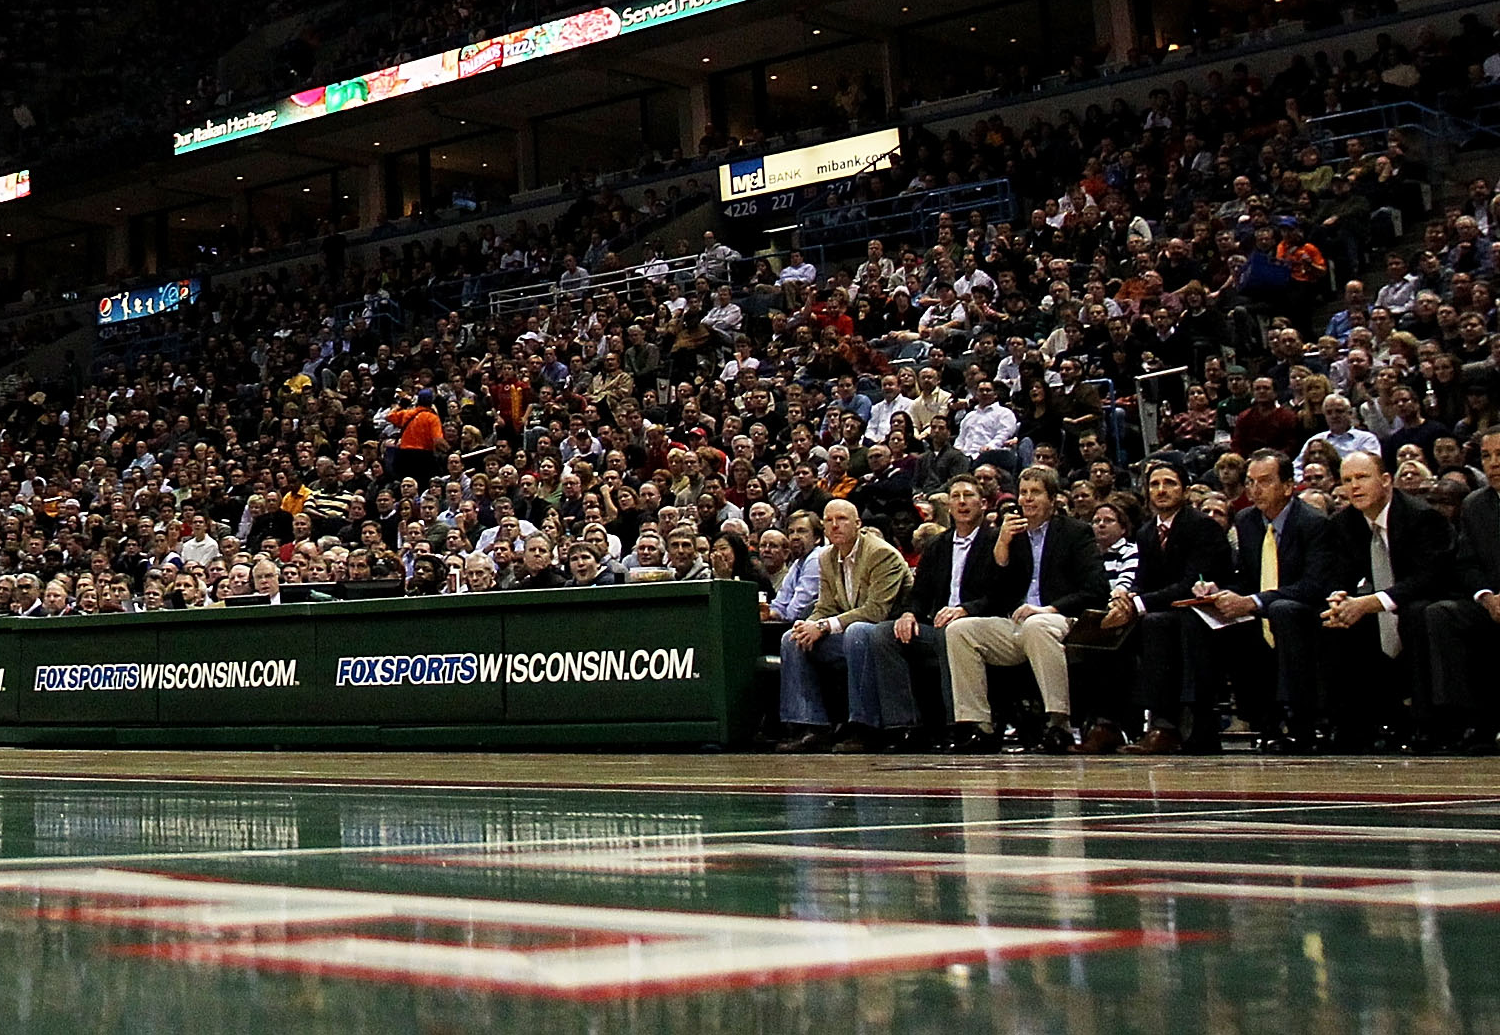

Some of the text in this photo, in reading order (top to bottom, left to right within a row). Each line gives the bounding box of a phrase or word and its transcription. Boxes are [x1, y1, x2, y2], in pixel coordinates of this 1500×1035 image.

[503, 38, 537, 59] PIZZA
[193, 119, 227, 142] Italian
[226, 109, 277, 131] Heritage
[768, 168, 803, 186] BANK
[731, 199, 758, 218] 226
[771, 193, 795, 211] 227
